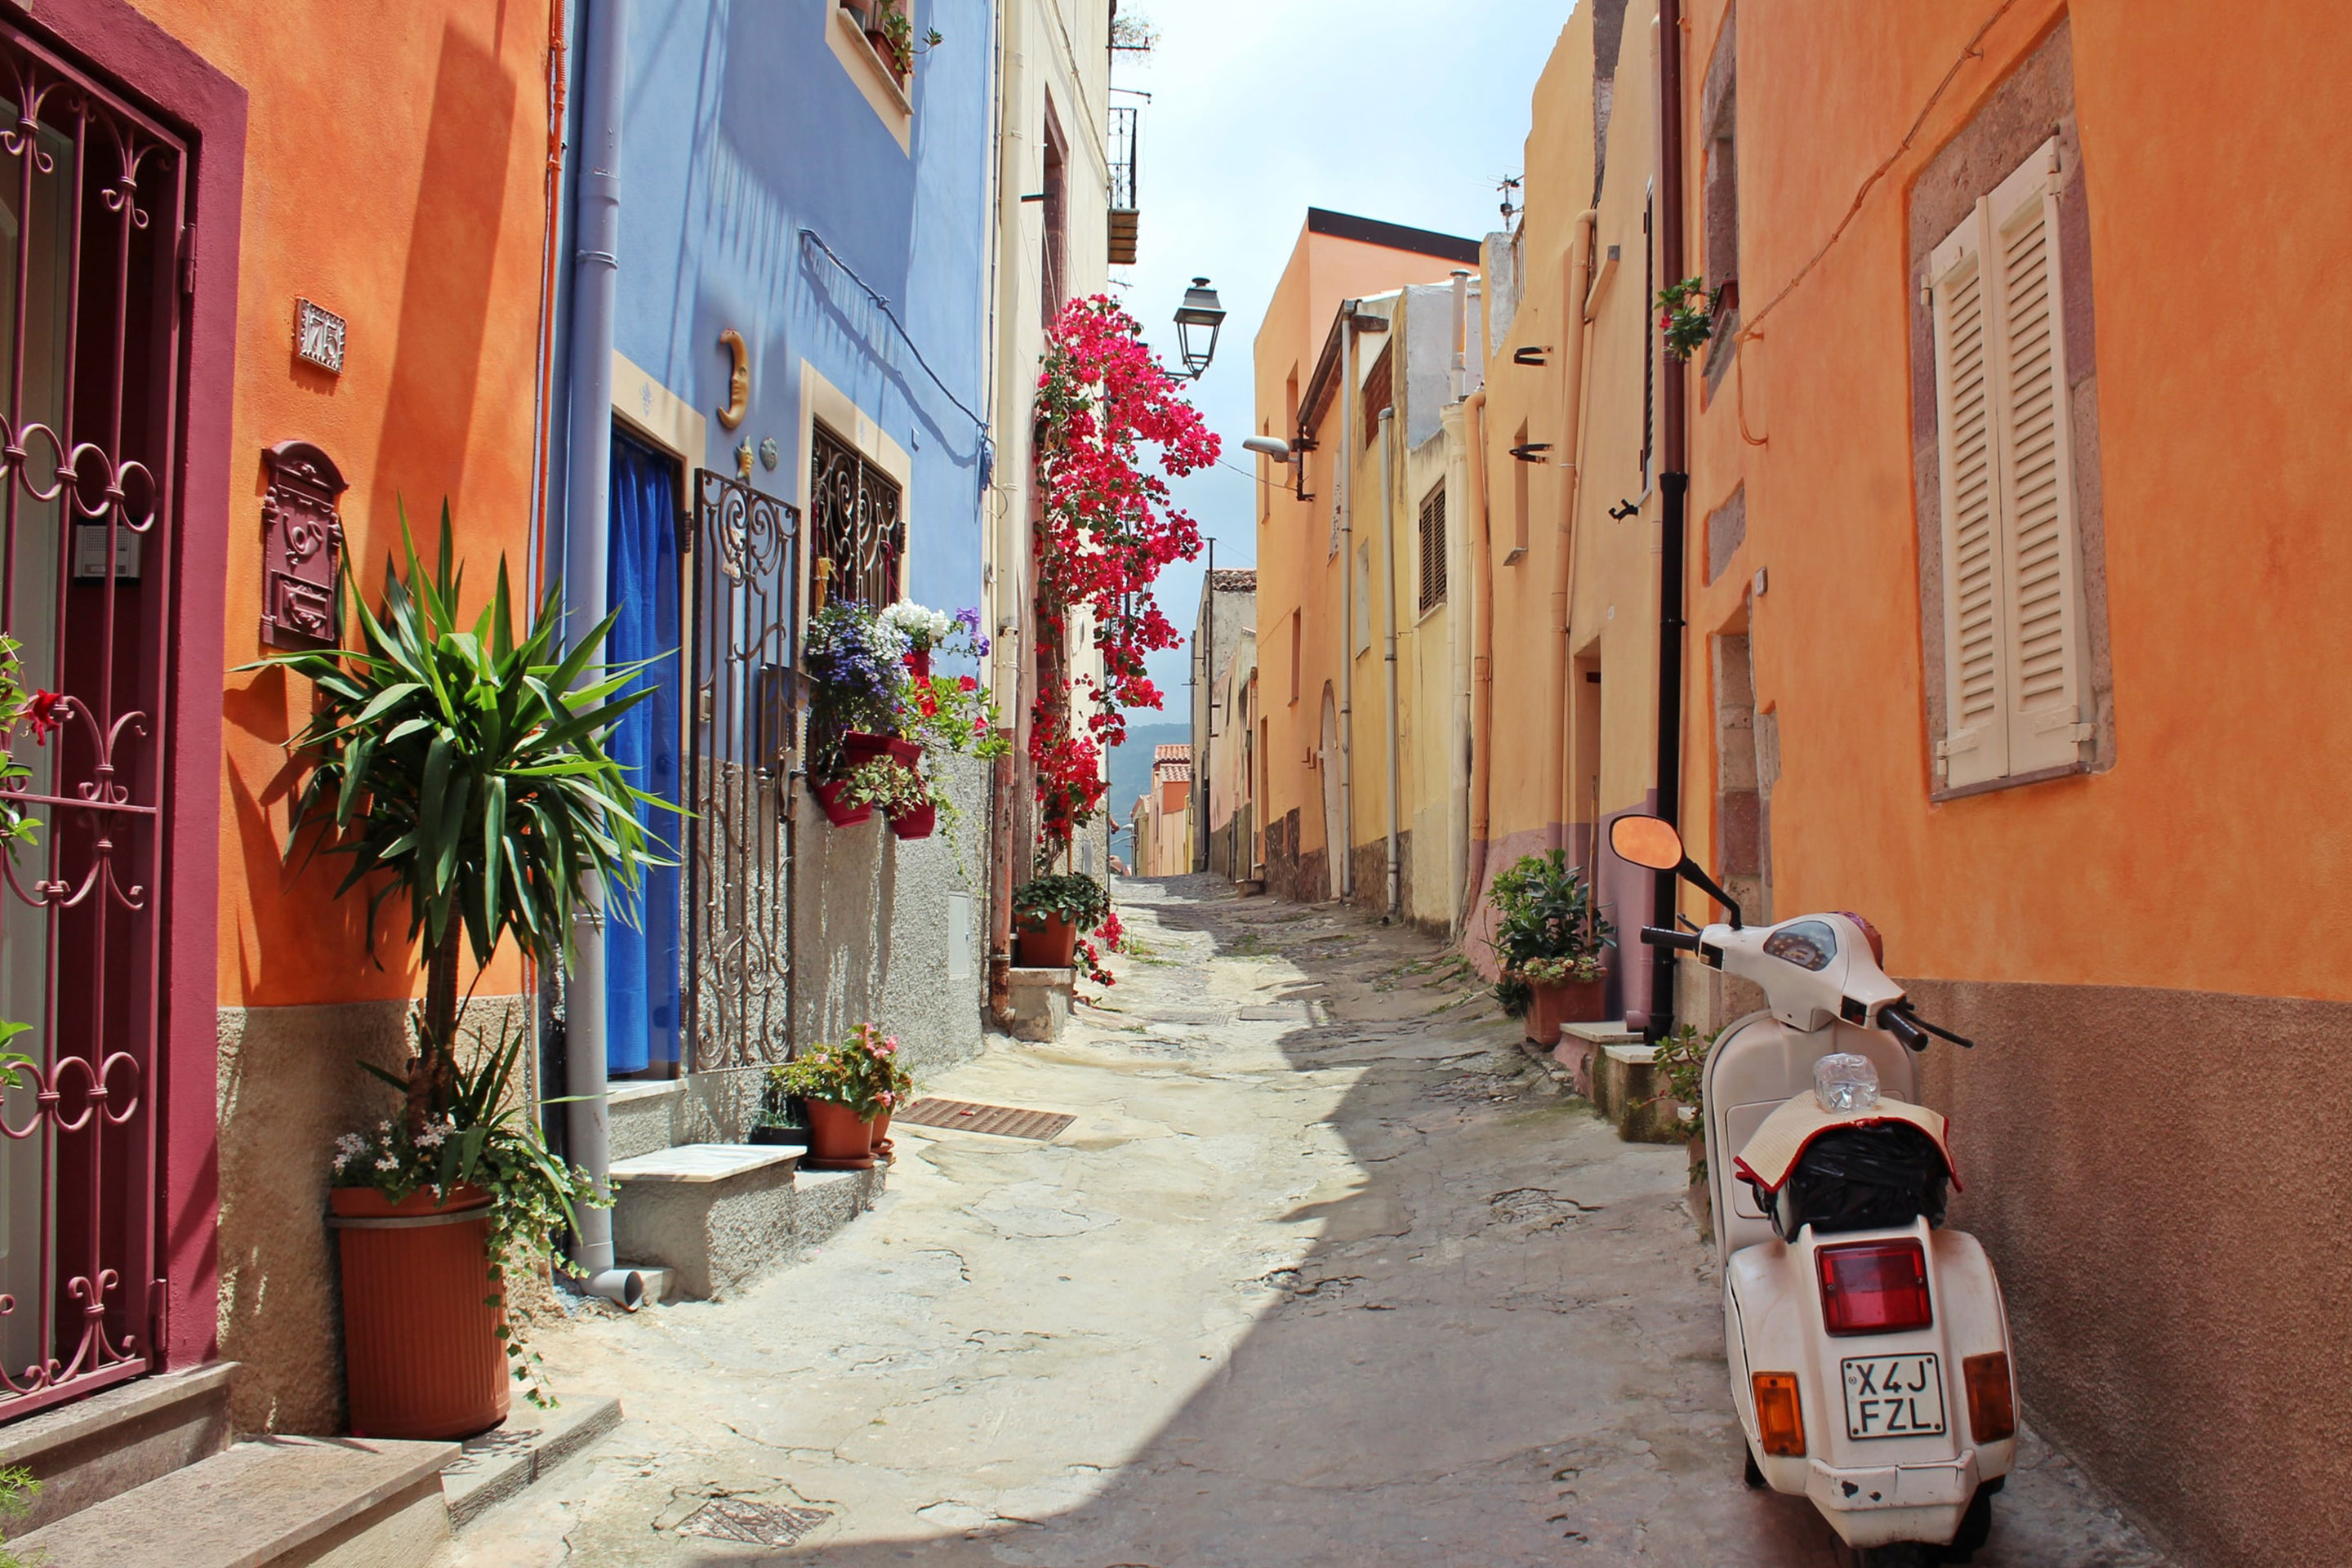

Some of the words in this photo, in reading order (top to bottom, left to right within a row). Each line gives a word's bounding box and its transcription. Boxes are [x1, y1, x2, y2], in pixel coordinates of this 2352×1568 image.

[310, 315, 338, 359] 75
[1856, 1361, 1926, 1395] X4J
[1860, 1397, 1931, 1432] FZL
